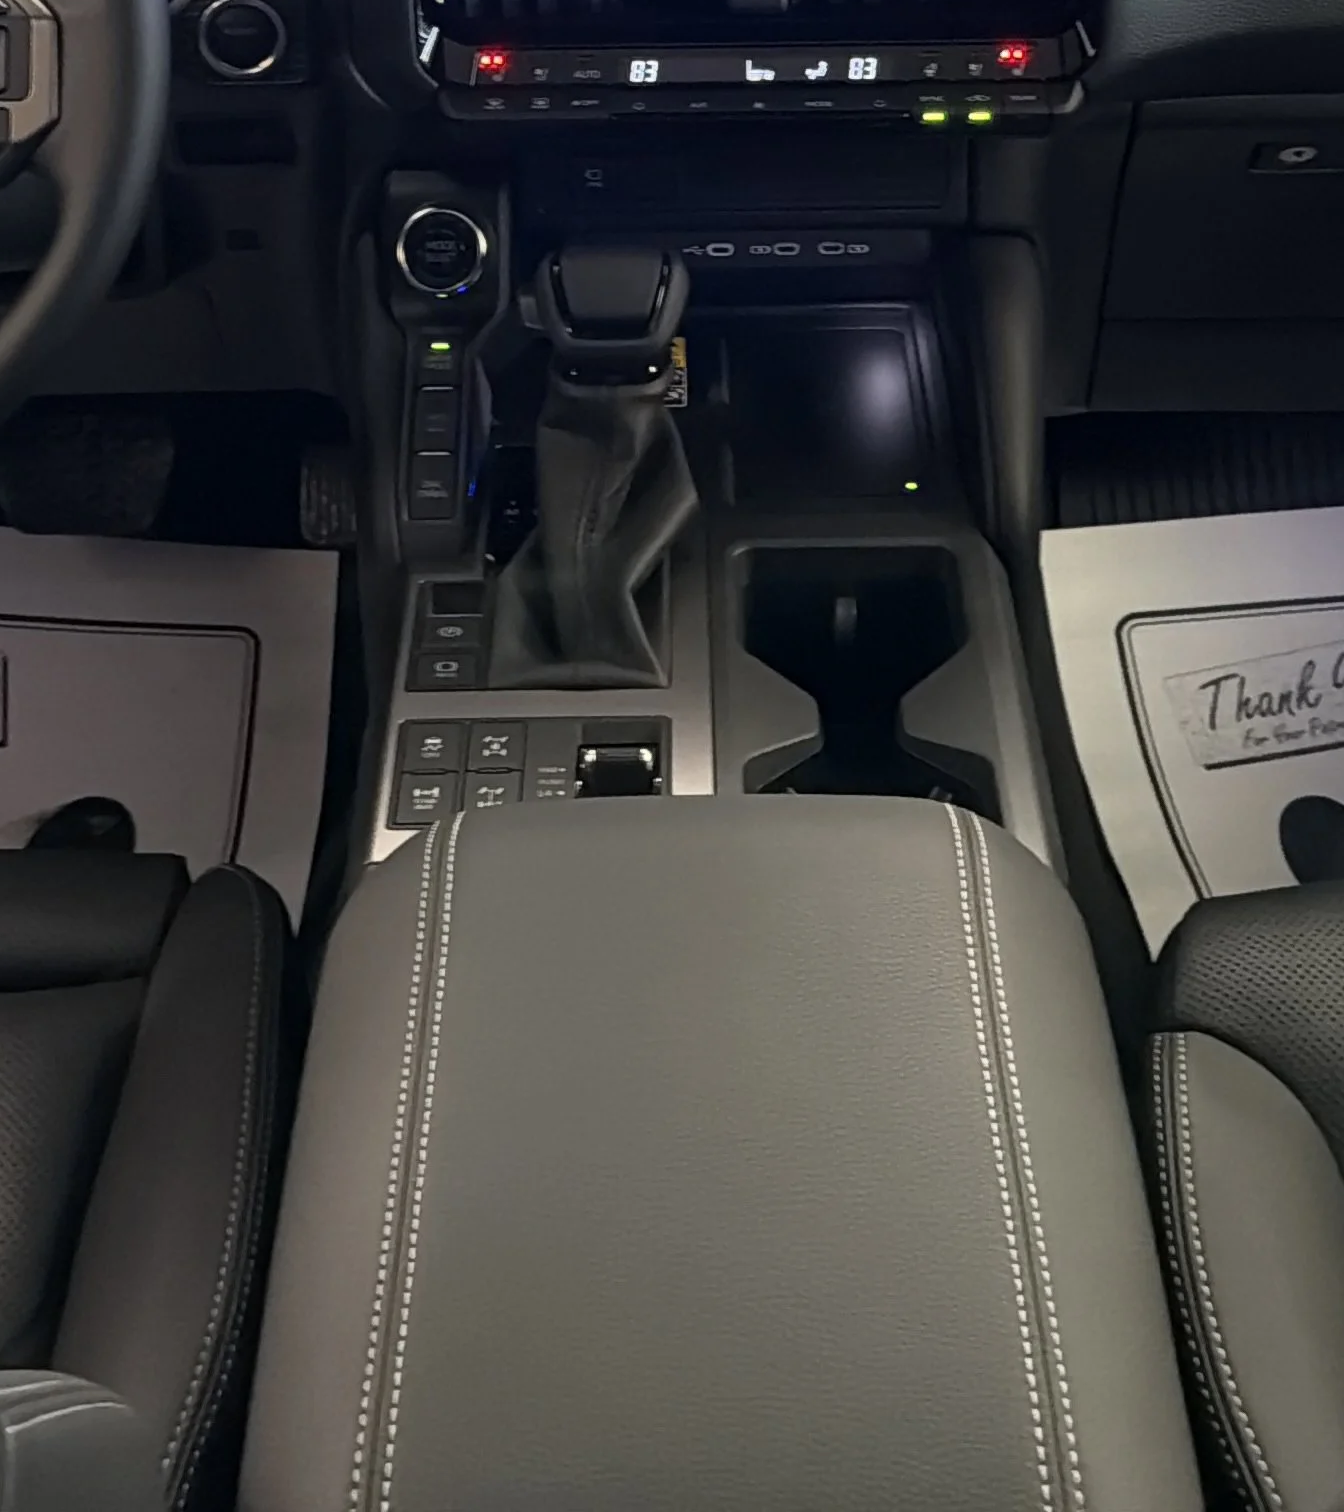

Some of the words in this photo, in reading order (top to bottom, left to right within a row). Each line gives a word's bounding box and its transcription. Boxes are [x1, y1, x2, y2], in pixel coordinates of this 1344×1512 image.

[573, 69, 601, 79] AUTO
[629, 59, 659, 83] 83
[848, 57, 877, 80] 83
[1199, 660, 1323, 730] Thank
